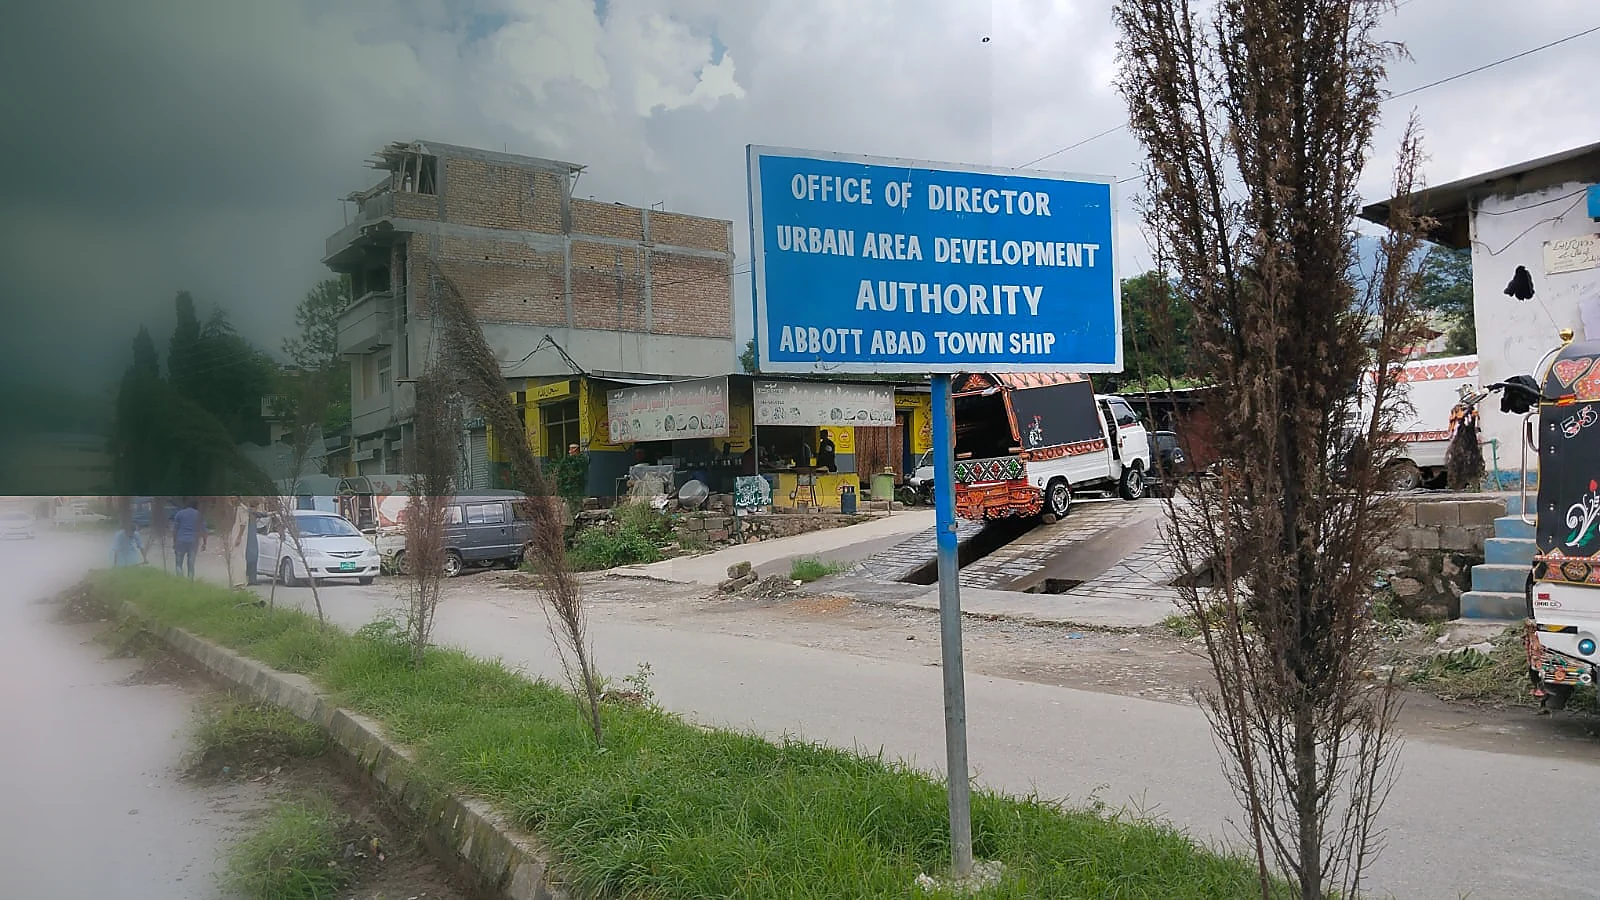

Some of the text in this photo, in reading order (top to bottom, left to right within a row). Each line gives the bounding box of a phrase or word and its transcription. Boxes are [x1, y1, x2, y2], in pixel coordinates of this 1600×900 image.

[792, 174, 1050, 216] OFFICE OF DIRECTOR
[778, 226, 1099, 267] URBAN AREA DEVELOPMENT
[856, 280, 1042, 315] AUTHORITY
[780, 326, 1055, 354] ABBOTT ABAD TOWN SHIP
